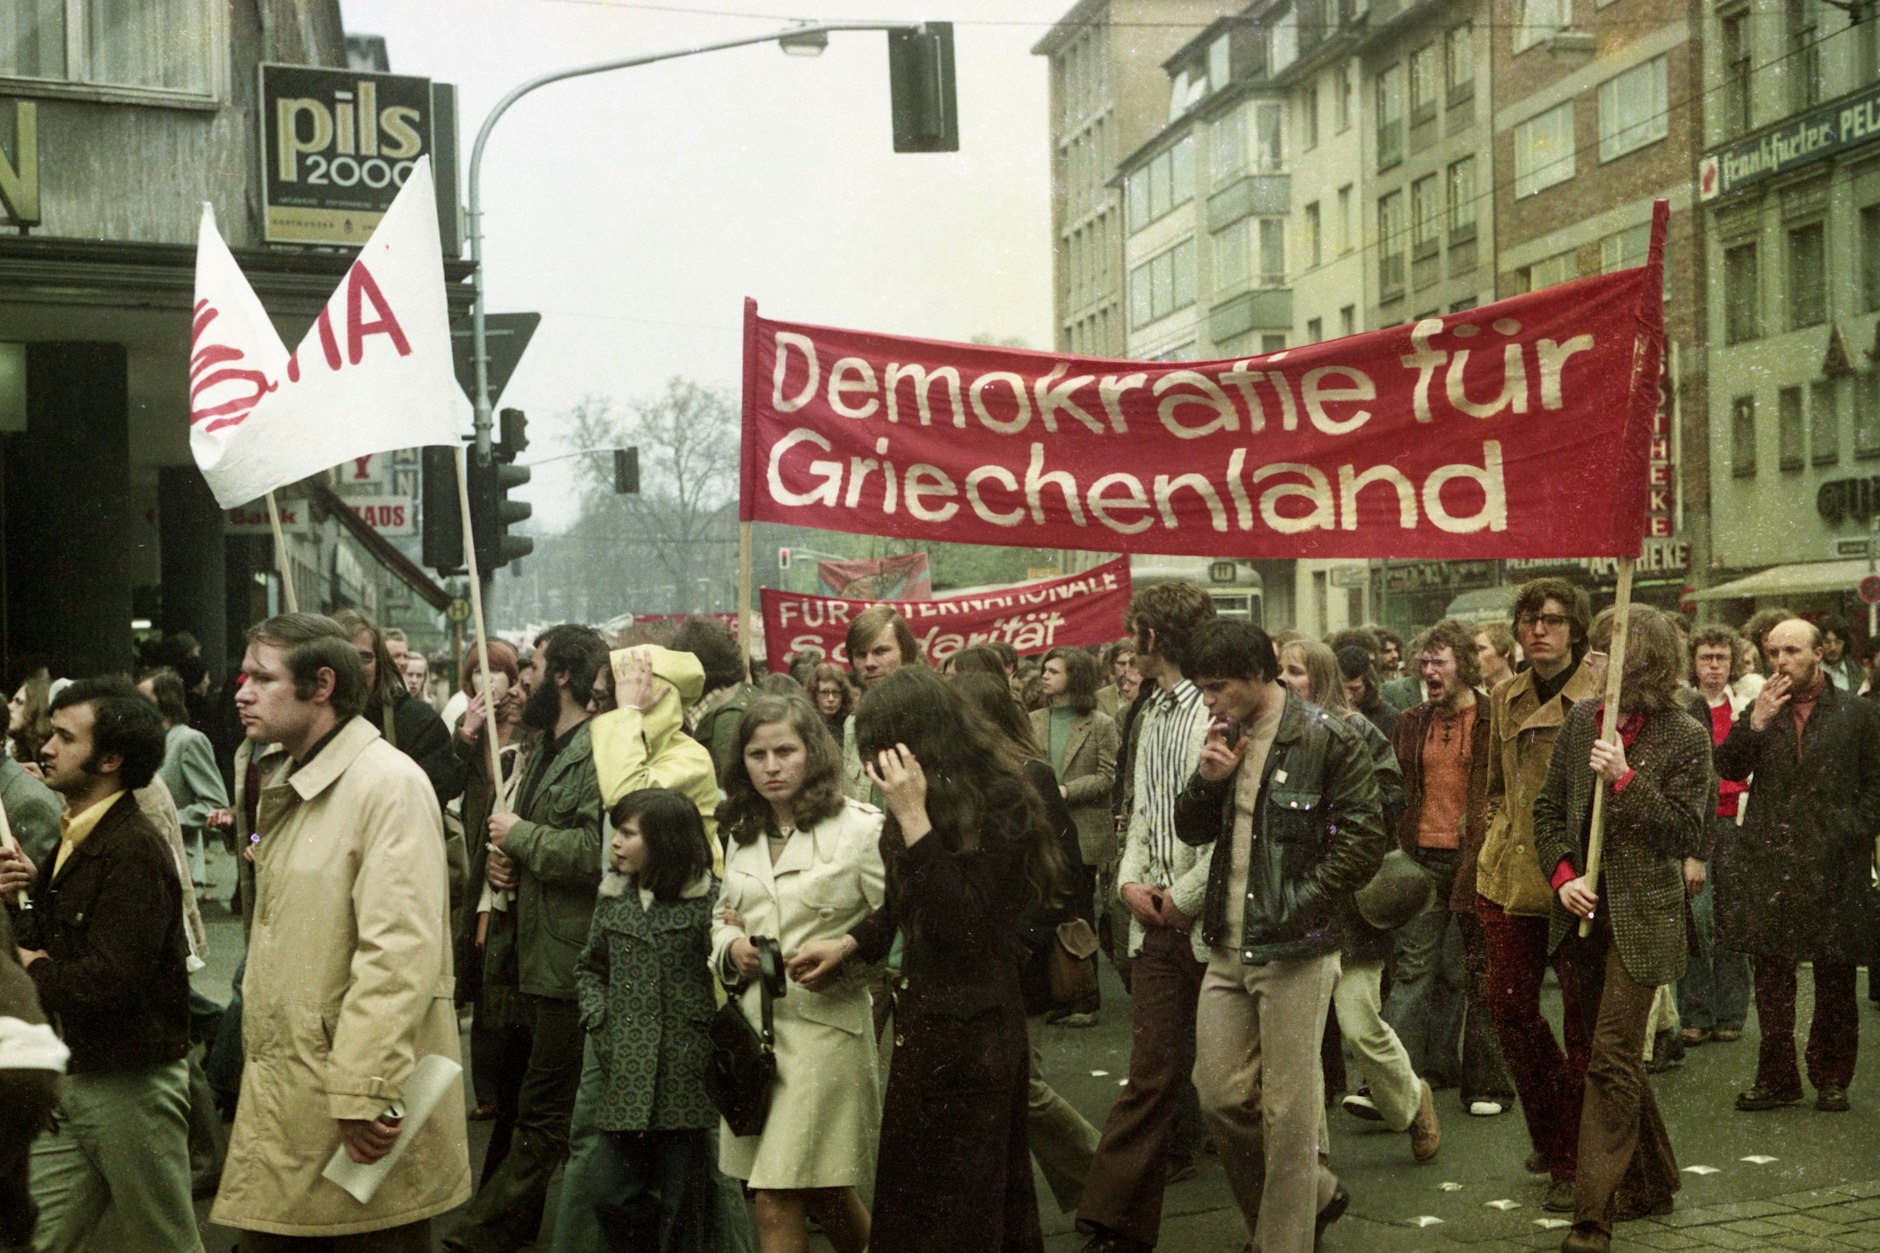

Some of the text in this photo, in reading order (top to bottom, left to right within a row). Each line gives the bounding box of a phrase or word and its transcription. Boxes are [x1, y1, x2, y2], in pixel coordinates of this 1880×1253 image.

[276, 81, 422, 183] pils
[772, 318, 1595, 439] Demokratie für
[767, 427, 1508, 535] Griechenland
[1651, 345, 1667, 538] THEKE
[1590, 542, 1688, 576] APHEKE
[779, 598, 850, 629] FÜR
[783, 611, 1066, 663] Sodarität
